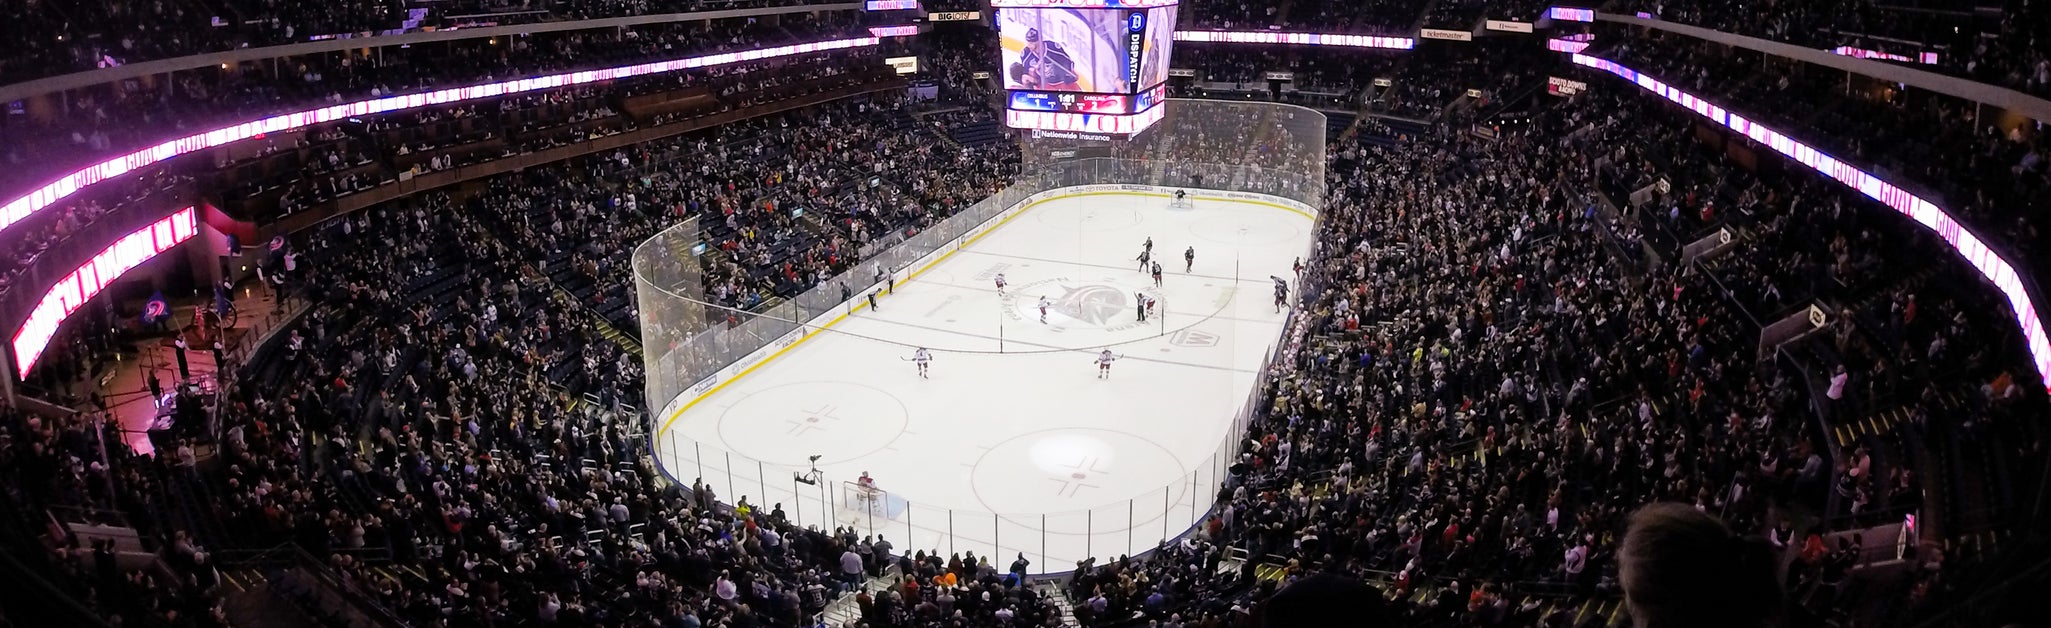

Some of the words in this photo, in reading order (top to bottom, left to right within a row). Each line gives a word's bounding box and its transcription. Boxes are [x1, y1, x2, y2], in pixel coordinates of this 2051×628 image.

[1427, 31, 1463, 39] ticketmaster
[1130, 34, 1140, 83] DISPATCH
[1035, 99, 1040, 107] 1
[1091, 102, 1098, 110] 2
[1041, 131, 1078, 139] Nationwide
[1079, 133, 1111, 142] Insurance
